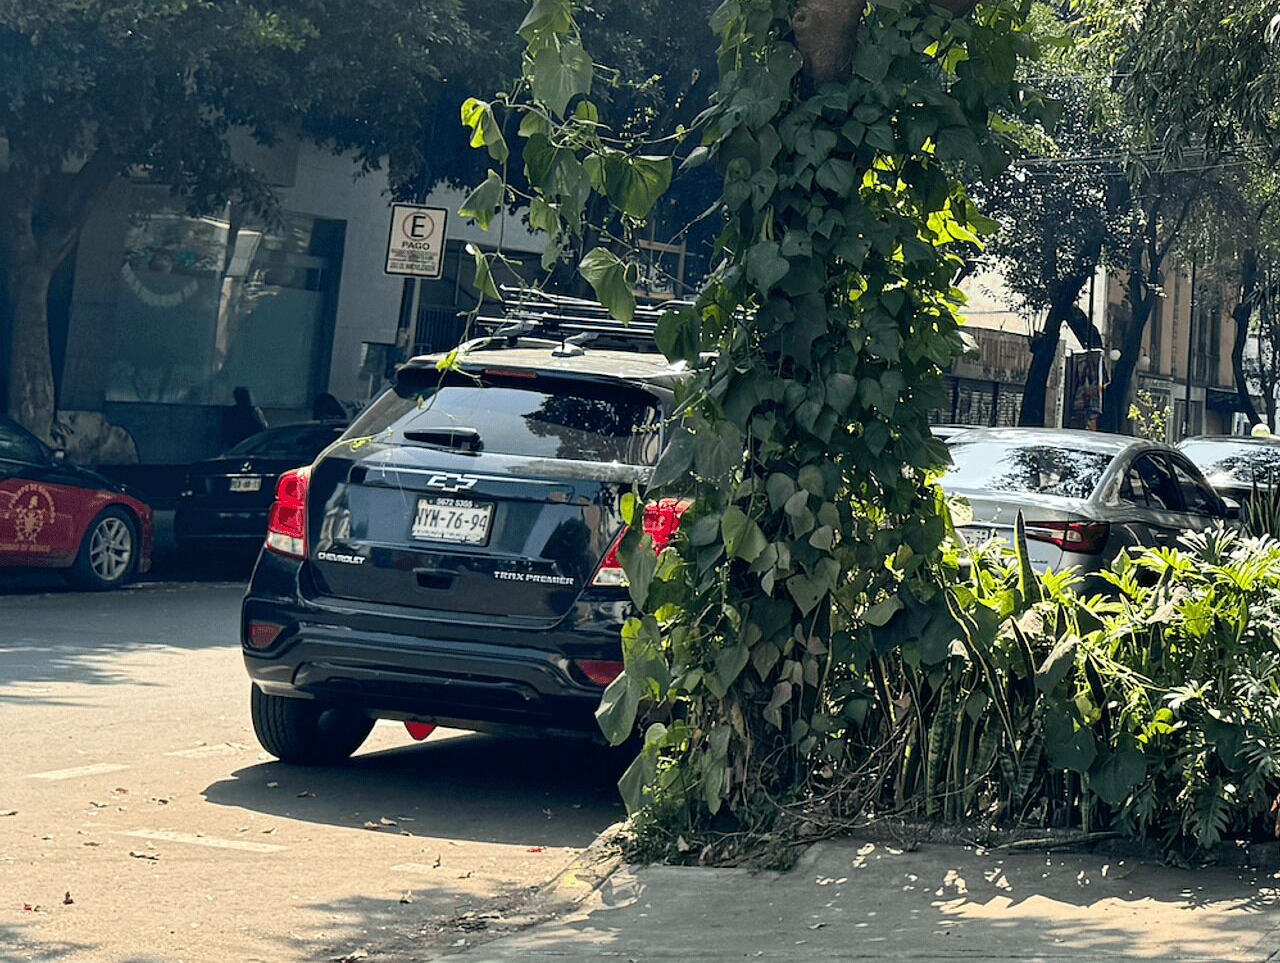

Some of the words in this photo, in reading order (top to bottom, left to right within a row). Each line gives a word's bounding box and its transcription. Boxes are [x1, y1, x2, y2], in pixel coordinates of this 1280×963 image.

[411, 216, 426, 238] E
[401, 241, 430, 250] PAGO
[494, 571, 524, 581] TRAX
[525, 574, 574, 585] PREMIER
